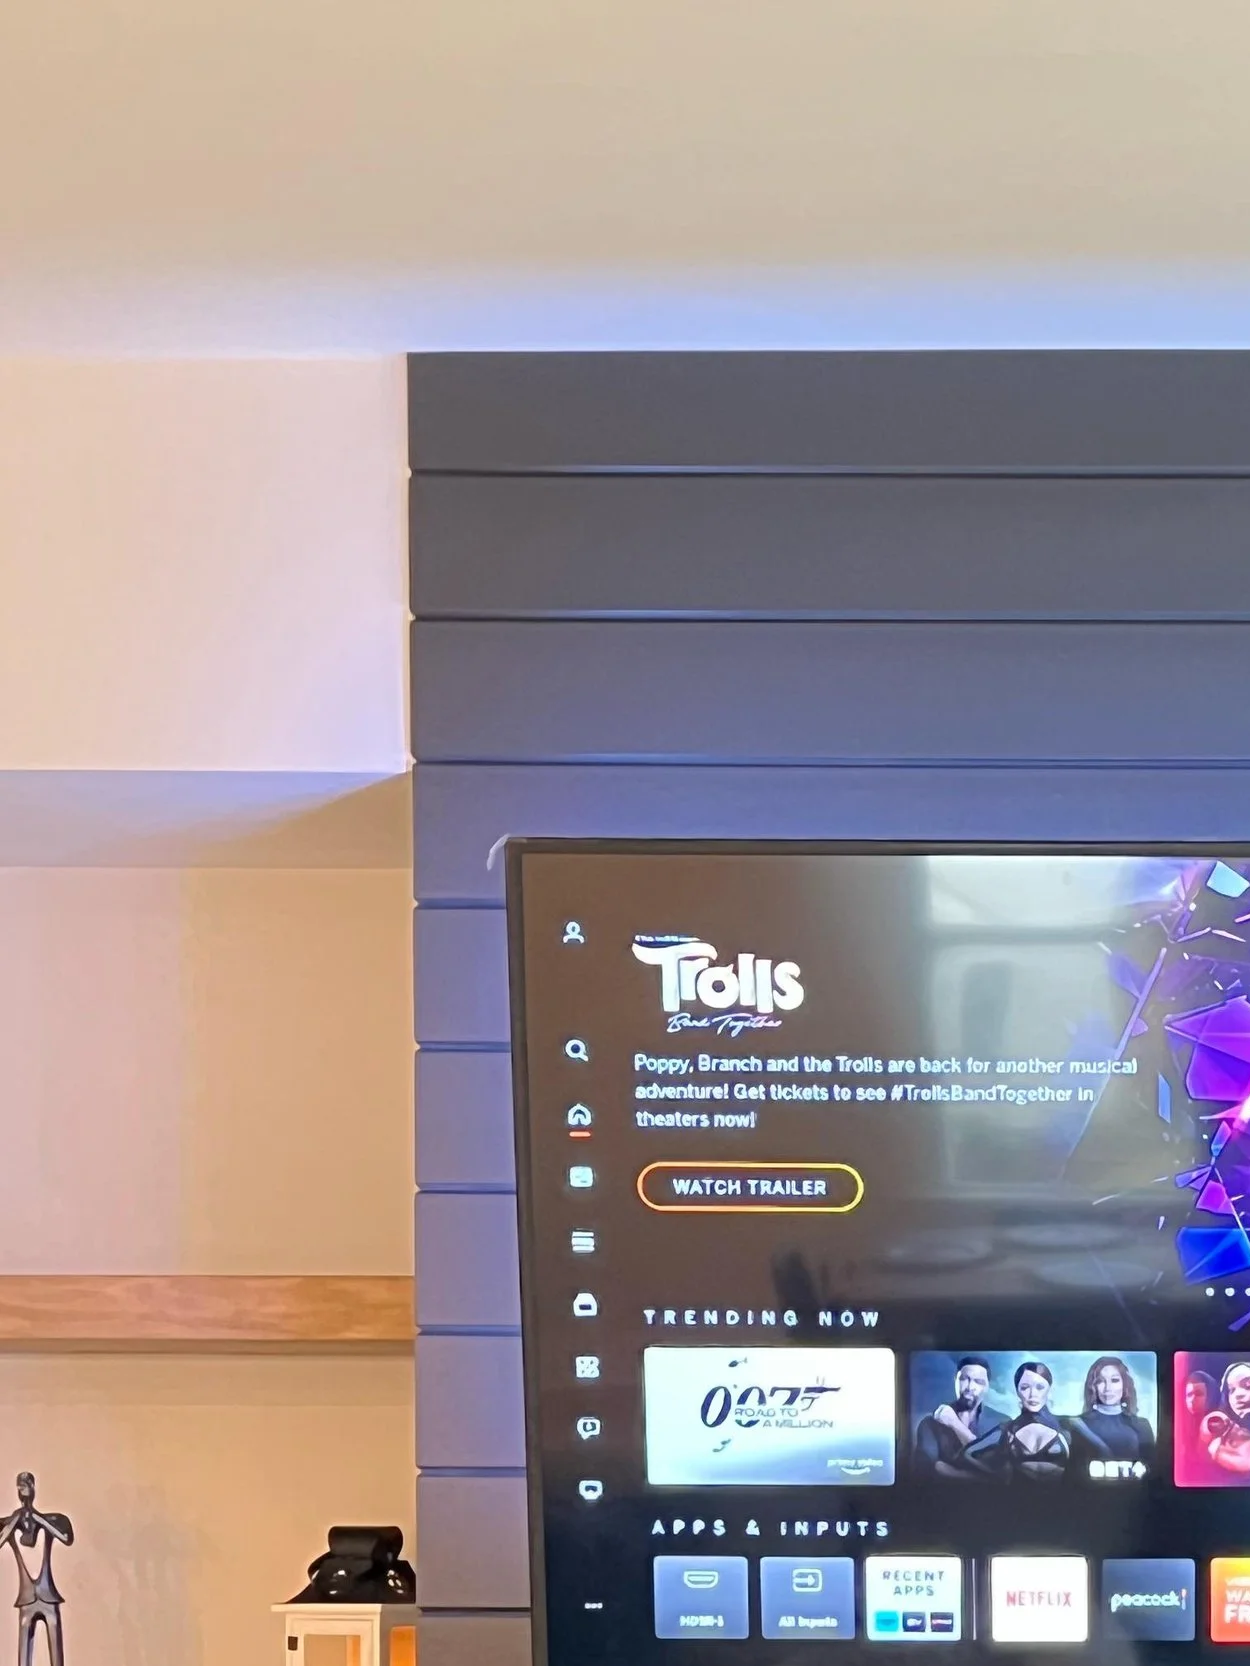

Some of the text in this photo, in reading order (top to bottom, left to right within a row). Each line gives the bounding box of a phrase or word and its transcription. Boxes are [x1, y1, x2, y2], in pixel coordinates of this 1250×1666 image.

[632, 942, 804, 1013] Trolls
[634, 1054, 1138, 1075] Poppy, Branch and the Trolls are back for another musical
[634, 1083, 1094, 1105] adventure! Get tickets to see #TrollsBandTogether in
[636, 1111, 756, 1128] theaters now!
[672, 1178, 827, 1196] WATCH TRAILER
[643, 1309, 879, 1328] TRENDING NOW
[700, 1385, 842, 1428] 007
[651, 1519, 889, 1537] APPS & INPUTS
[882, 1570, 945, 1581] RECENT
[893, 1585, 935, 1597] APPS
[1006, 1591, 1072, 1608] NETFLIX
